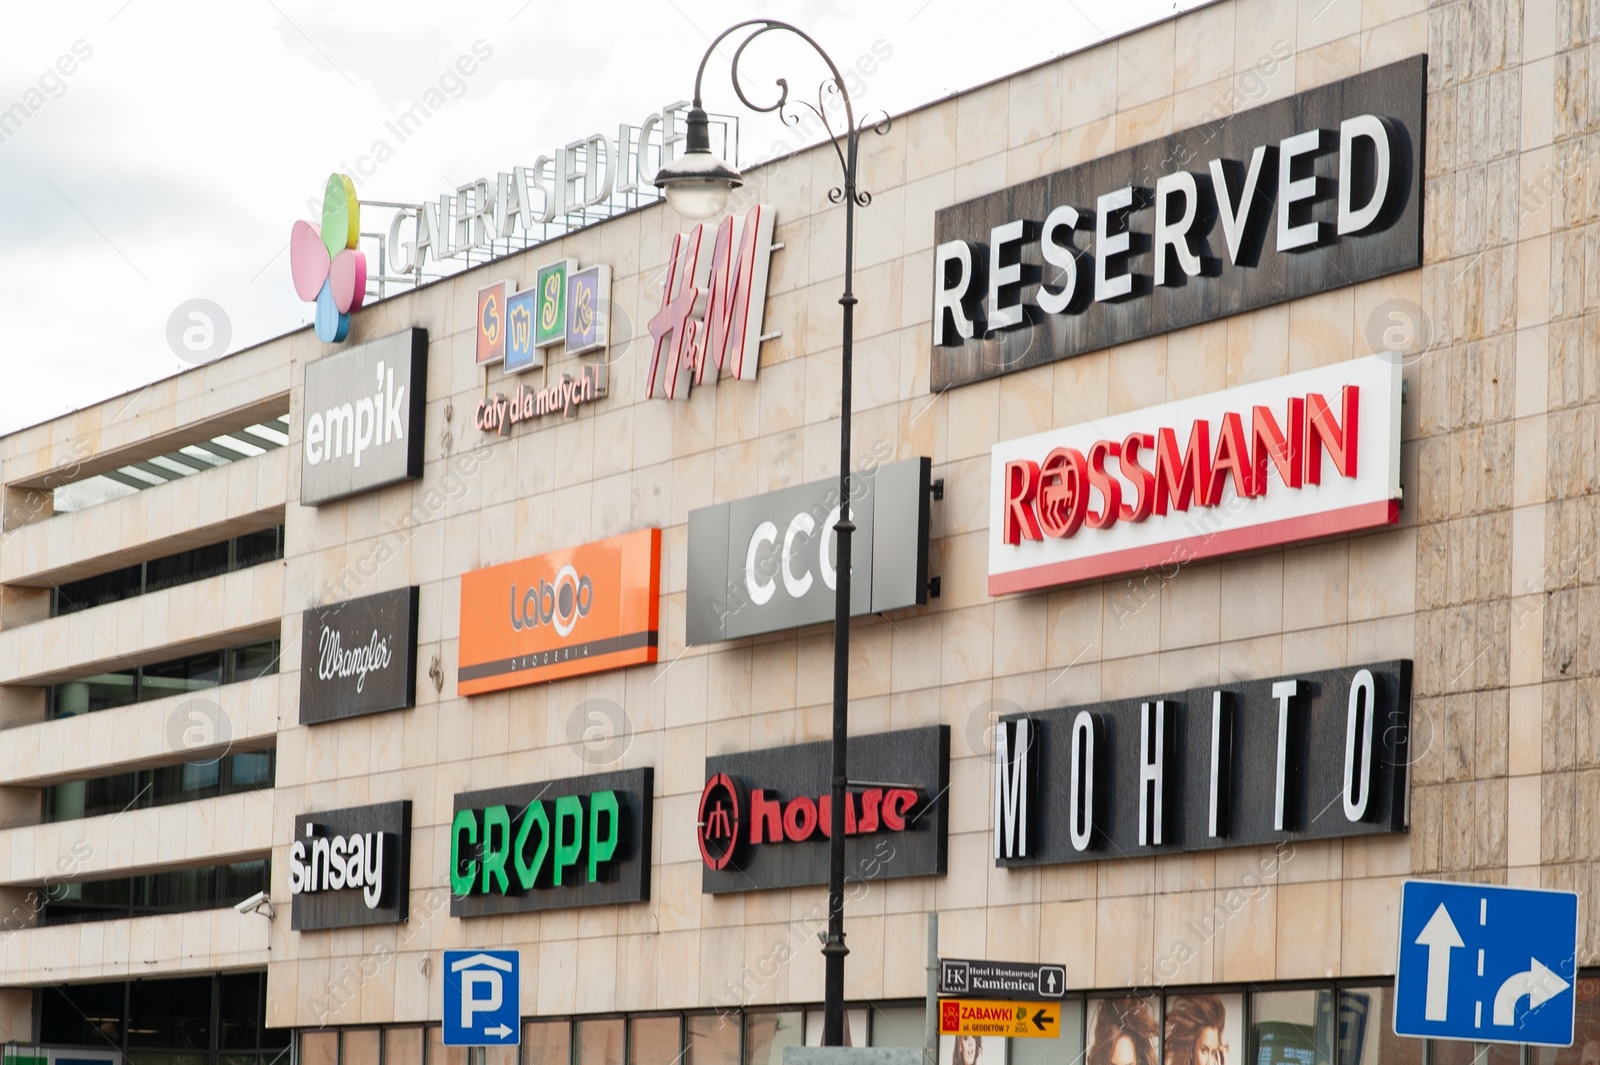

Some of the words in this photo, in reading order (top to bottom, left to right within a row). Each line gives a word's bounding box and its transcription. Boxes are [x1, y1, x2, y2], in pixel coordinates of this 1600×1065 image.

[934, 114, 1392, 347] RESERVED
[646, 204, 770, 400] H&M
[306, 360, 405, 468] empik
[510, 384, 533, 424] dla
[1003, 385, 1360, 546] ROSSMANN
[318, 626, 392, 694] Wrangler
[511, 645, 589, 671] DROGERIA
[994, 668, 1375, 859] MOHITO
[450, 789, 619, 896] CROPP
[750, 788, 919, 845] house
[288, 822, 384, 910] sinsay
[461, 969, 503, 1029] P
[969, 967, 991, 976] Hotel
[995, 968, 1038, 979] Restauracja
[973, 977, 1035, 991] Kamienica
[961, 1006, 1013, 1021] ZABAWKI
